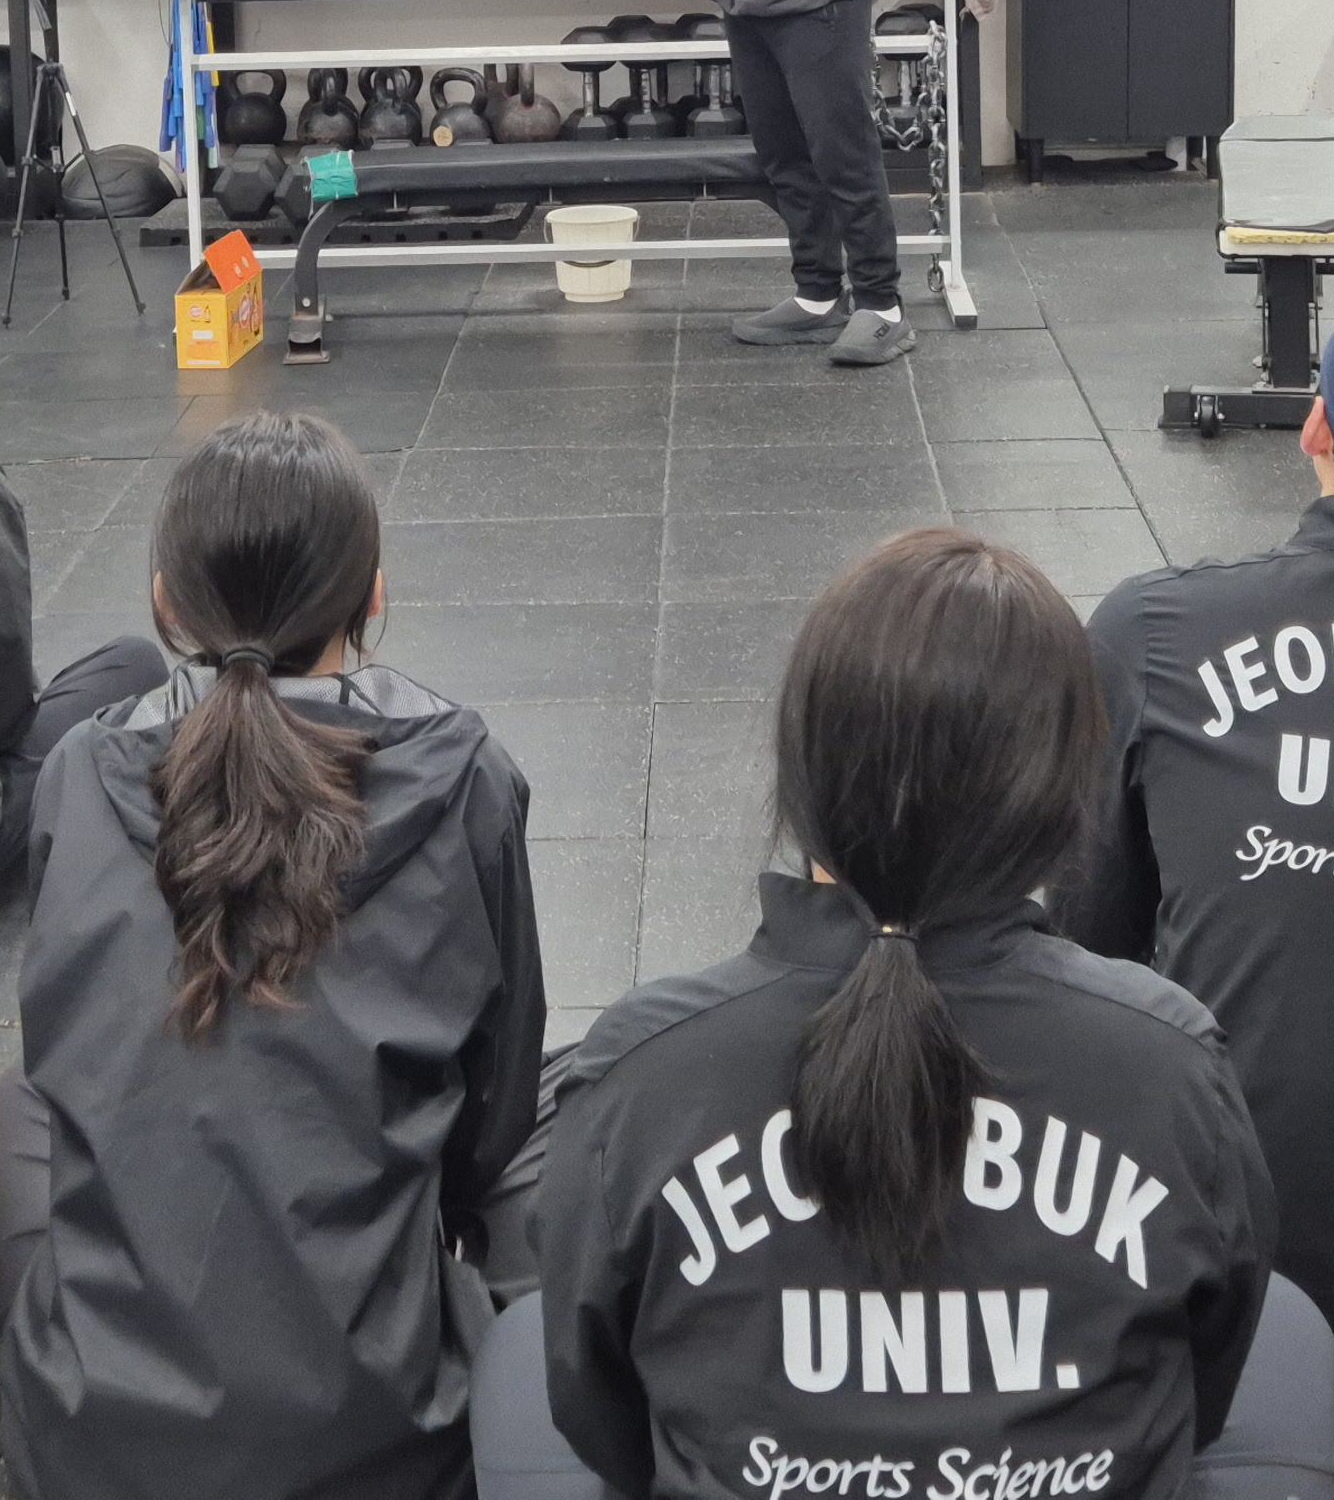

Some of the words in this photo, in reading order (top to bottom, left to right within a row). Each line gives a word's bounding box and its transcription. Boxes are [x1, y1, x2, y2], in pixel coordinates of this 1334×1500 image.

[661, 1109, 820, 1287] JEO
[962, 1097, 1169, 1290] BUK
[781, 1288, 1081, 1394] UNIV.
[742, 1436, 915, 1500] Sports
[926, 1446, 1114, 1500] Science
